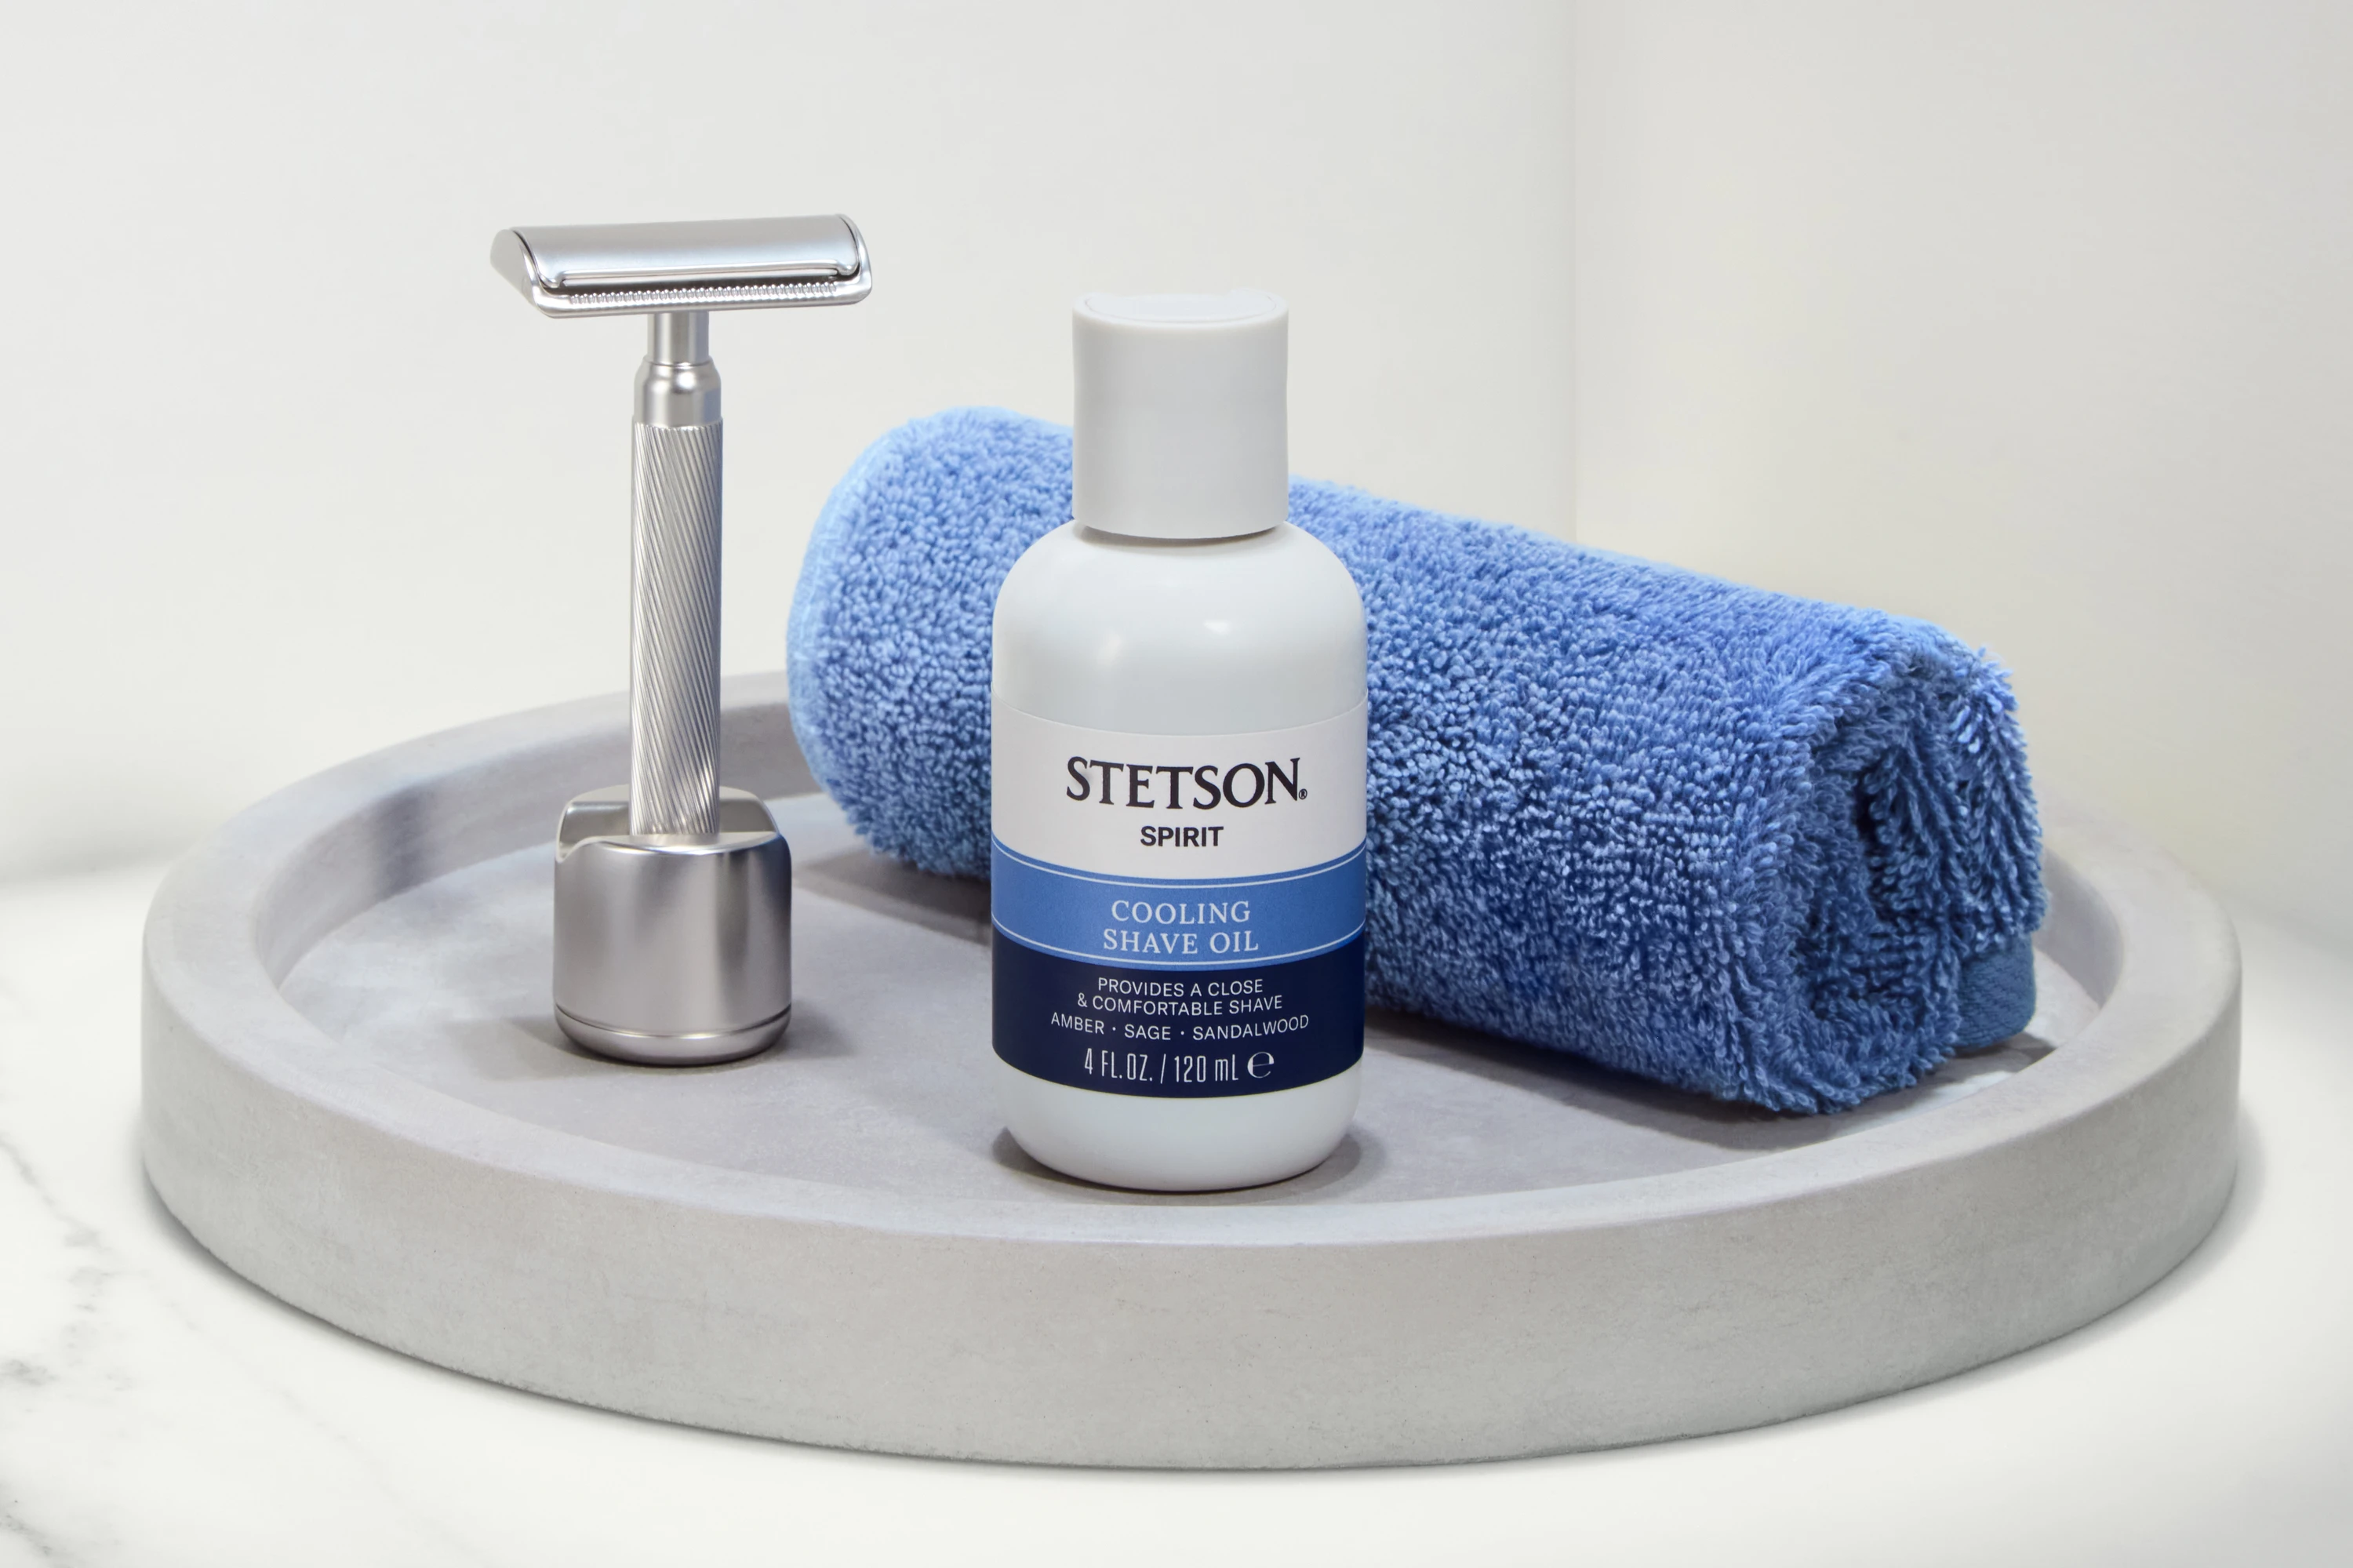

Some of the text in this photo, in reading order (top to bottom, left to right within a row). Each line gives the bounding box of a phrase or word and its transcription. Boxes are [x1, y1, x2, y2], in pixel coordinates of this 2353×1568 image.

[1140, 826, 1224, 847] SPIRIT
[1111, 900, 1249, 924] COOLING
[1104, 929, 1258, 954] SHAVE OIL
[1098, 977, 1263, 997] PROVIDES A CLOSE
[1078, 993, 1282, 1015] & COMFORTABLE SHAVE
[1052, 1012, 1308, 1040] AMBER SAGE SANDALWOOD
[1085, 1048, 1093, 1074] 4
[1161, 1054, 1166, 1083] /
[1175, 1056, 1206, 1082] 120
[1216, 1054, 1238, 1081] ml
